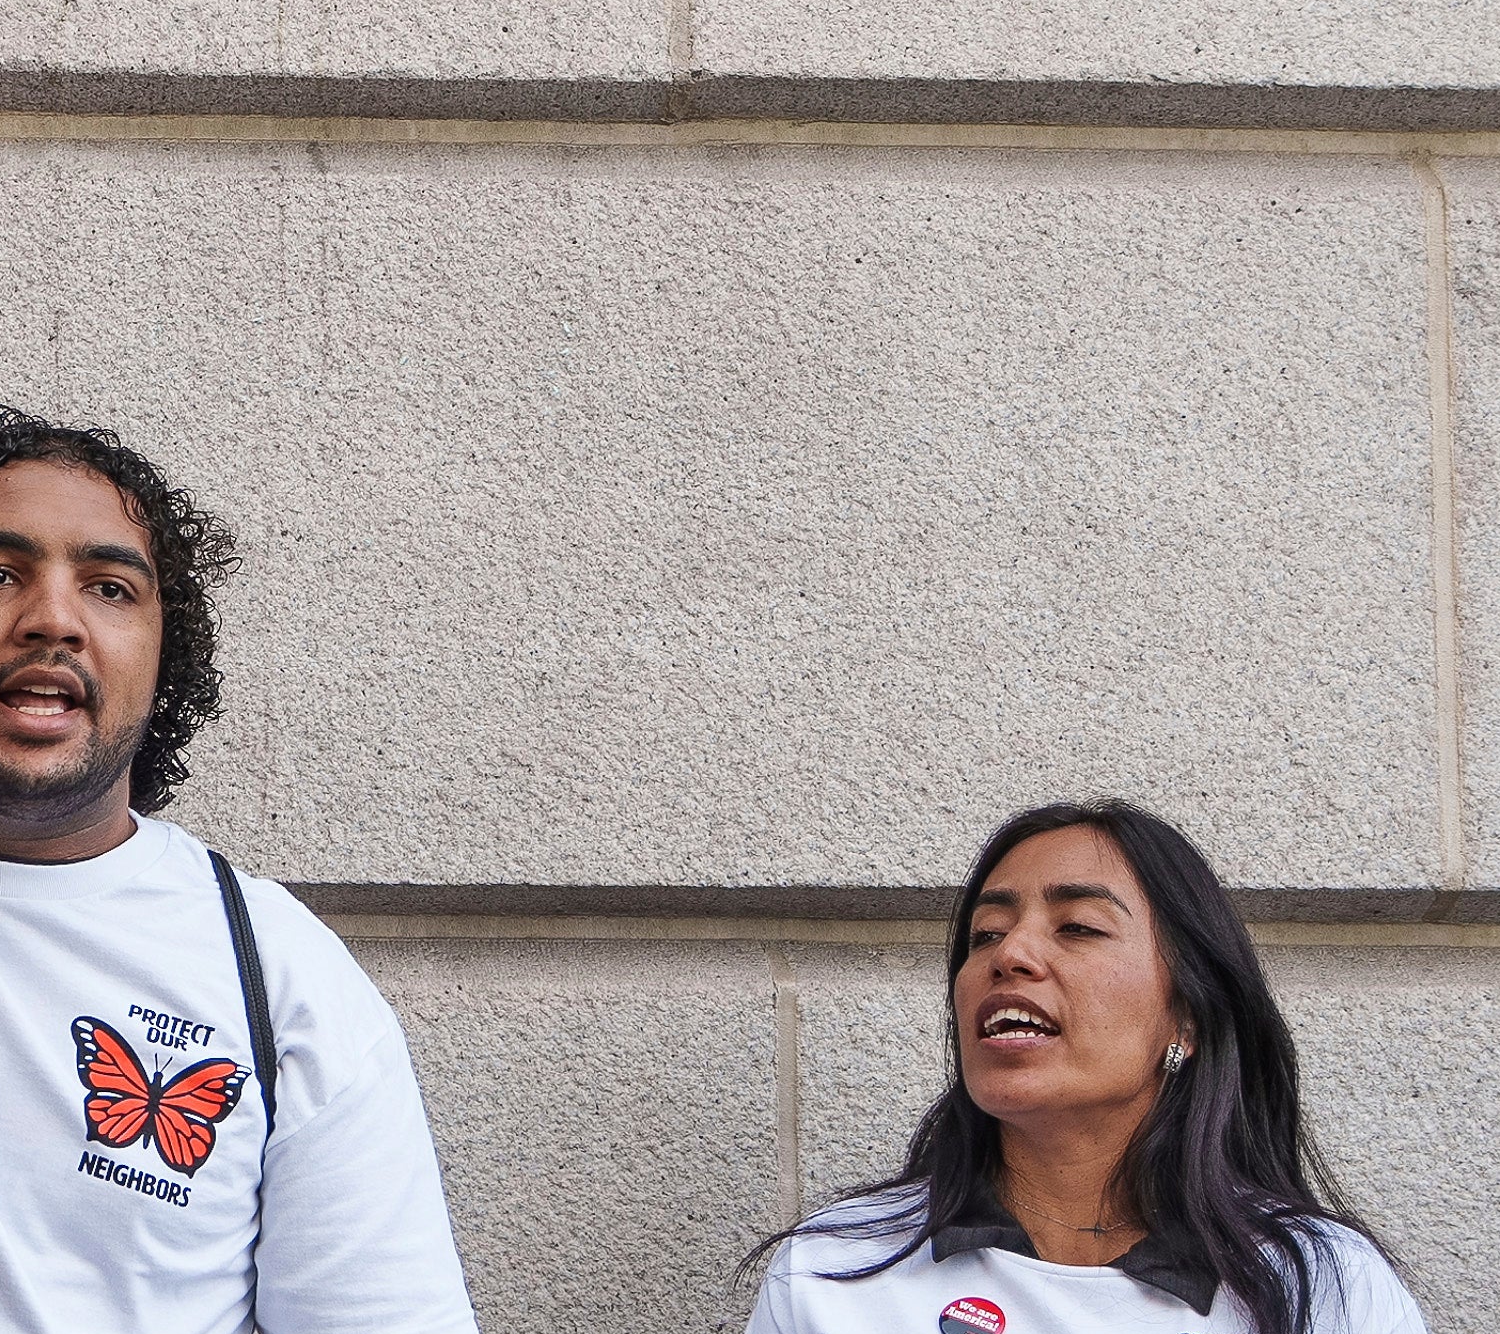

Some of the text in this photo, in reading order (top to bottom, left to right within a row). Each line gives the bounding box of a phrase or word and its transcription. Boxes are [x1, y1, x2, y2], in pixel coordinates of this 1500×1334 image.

[127, 1004, 216, 1047] PROTECT
[146, 1027, 188, 1052] OUR
[77, 1150, 192, 1208] NEIGHBORS
[945, 1306, 1000, 1332] America!
[959, 1300, 999, 1322] We are
